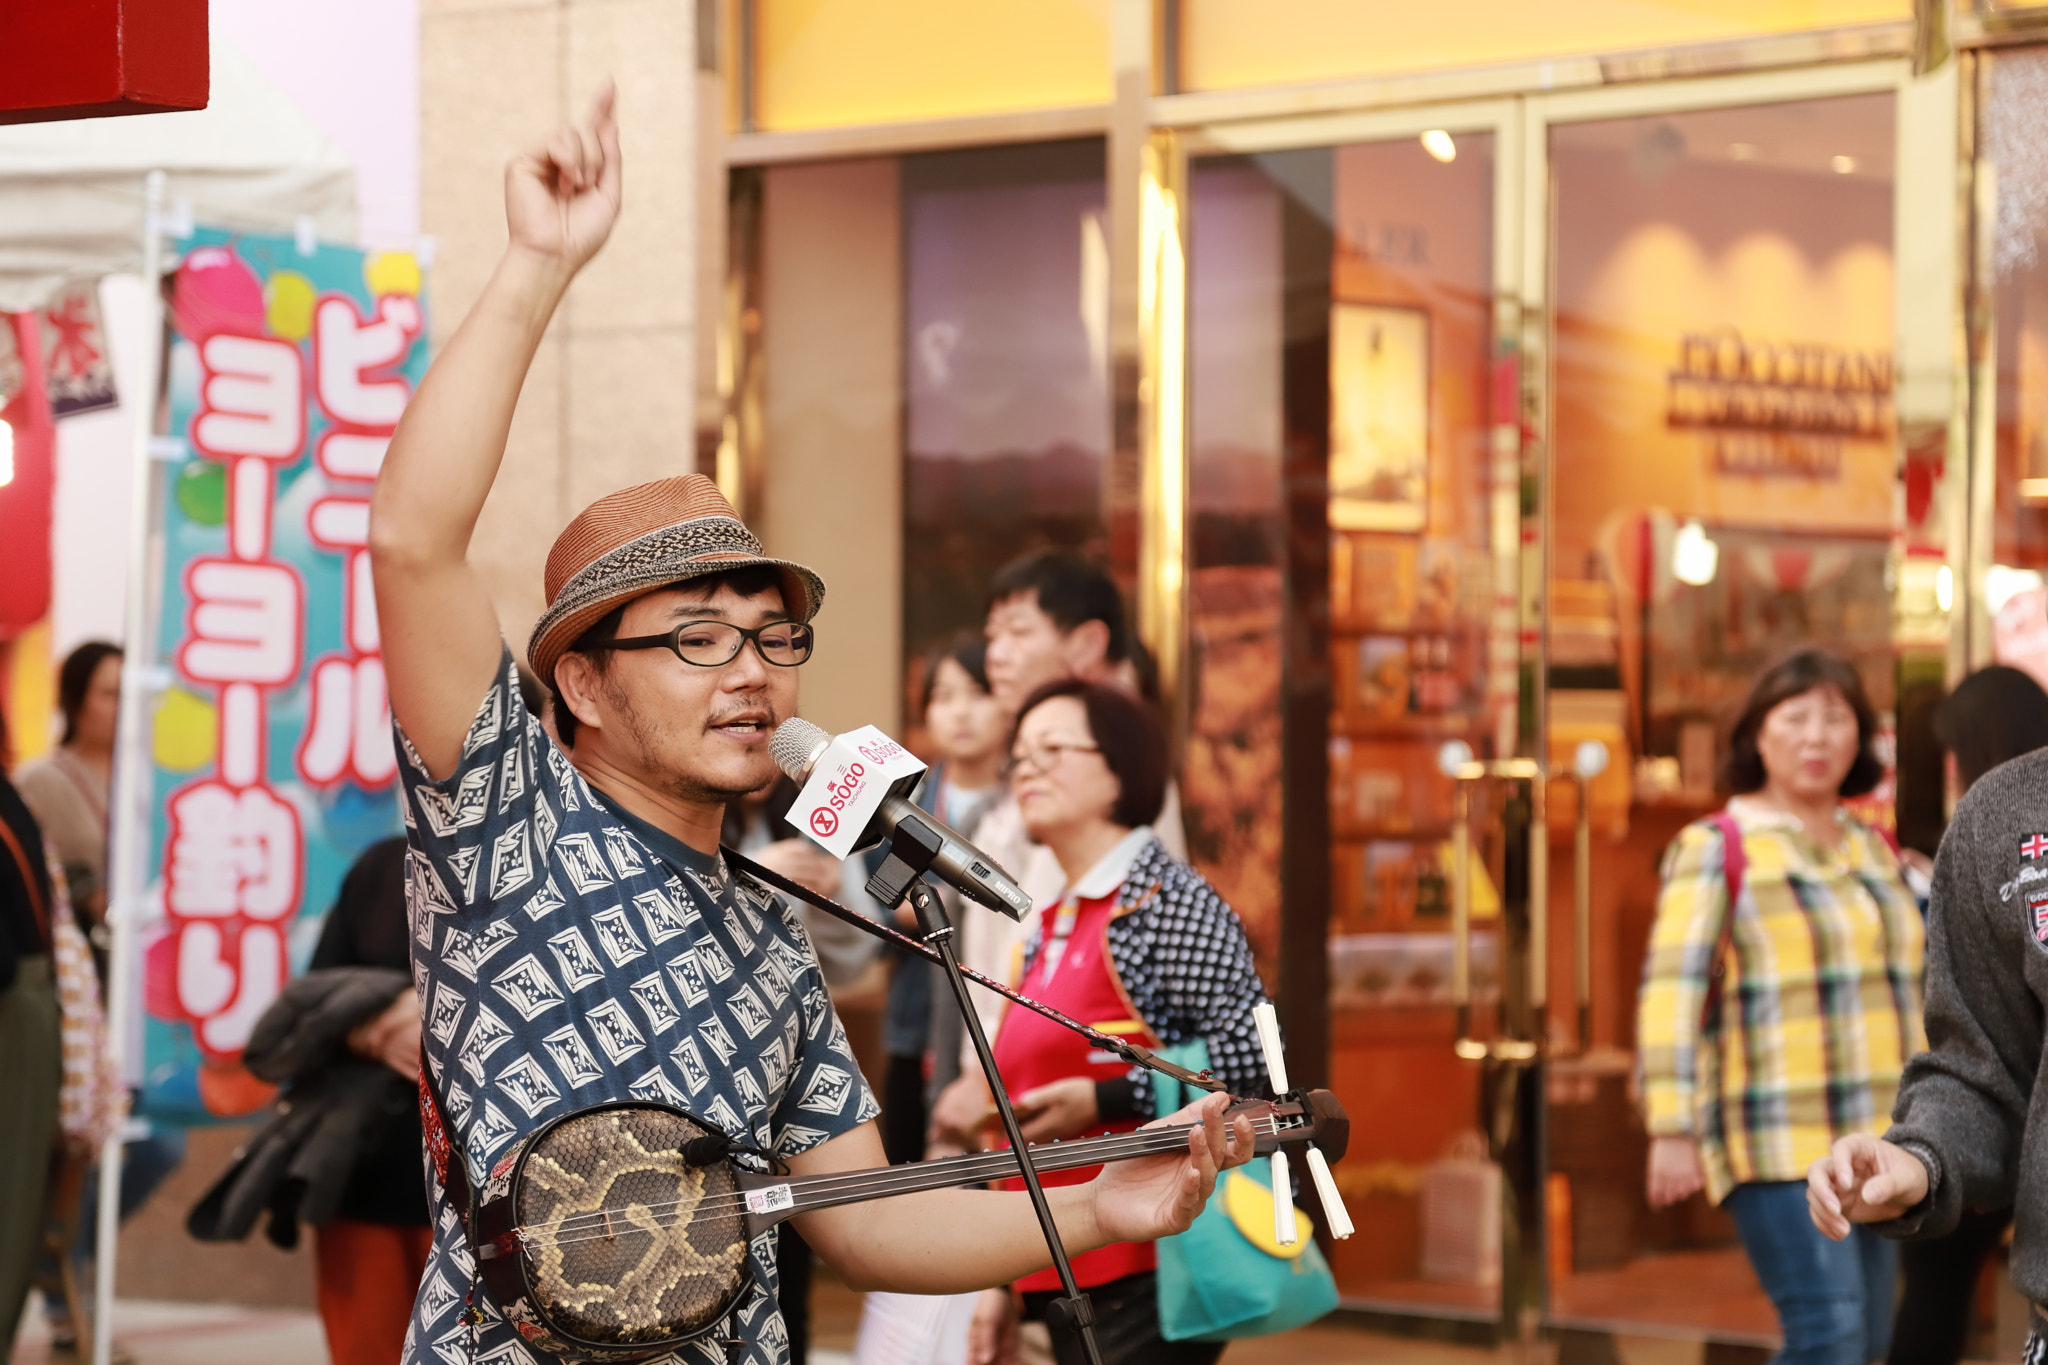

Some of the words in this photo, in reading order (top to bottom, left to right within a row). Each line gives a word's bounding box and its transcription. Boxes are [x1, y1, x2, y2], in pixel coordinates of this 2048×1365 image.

[167, 333, 304, 1058] ヨーヨー釣り
[830, 763, 865, 811] SOGO
[848, 781, 867, 807] TAICHUNG
[994, 881, 1021, 904] MIPRO
